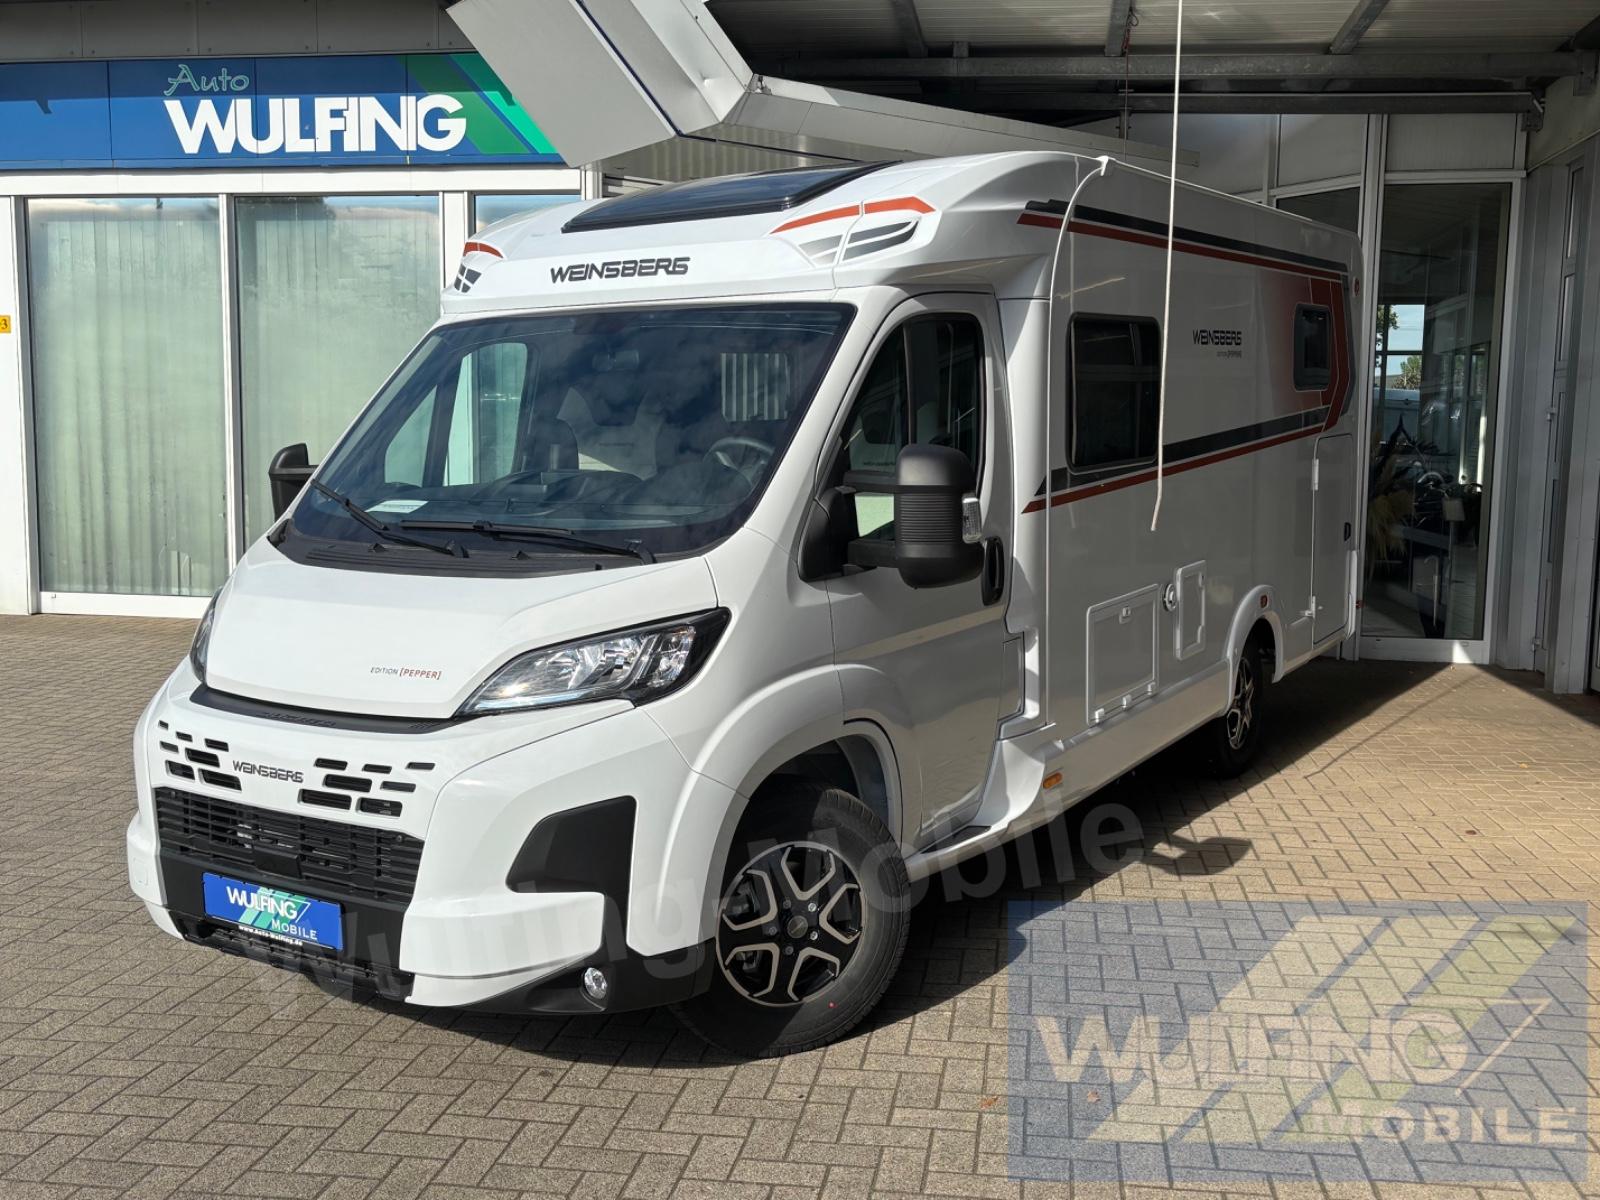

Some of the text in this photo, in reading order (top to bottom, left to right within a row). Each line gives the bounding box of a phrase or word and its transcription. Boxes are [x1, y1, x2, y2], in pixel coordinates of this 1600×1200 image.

[163, 63, 250, 96] Auto
[163, 94, 467, 155] WULFING
[550, 256, 691, 284] WEINSBERG
[1192, 329, 1243, 346] WEINSBERG
[370, 667, 398, 675] EDITION
[232, 759, 304, 784] WEINSBERG
[226, 886, 298, 919] WULFING
[272, 918, 317, 940] MOBILE
